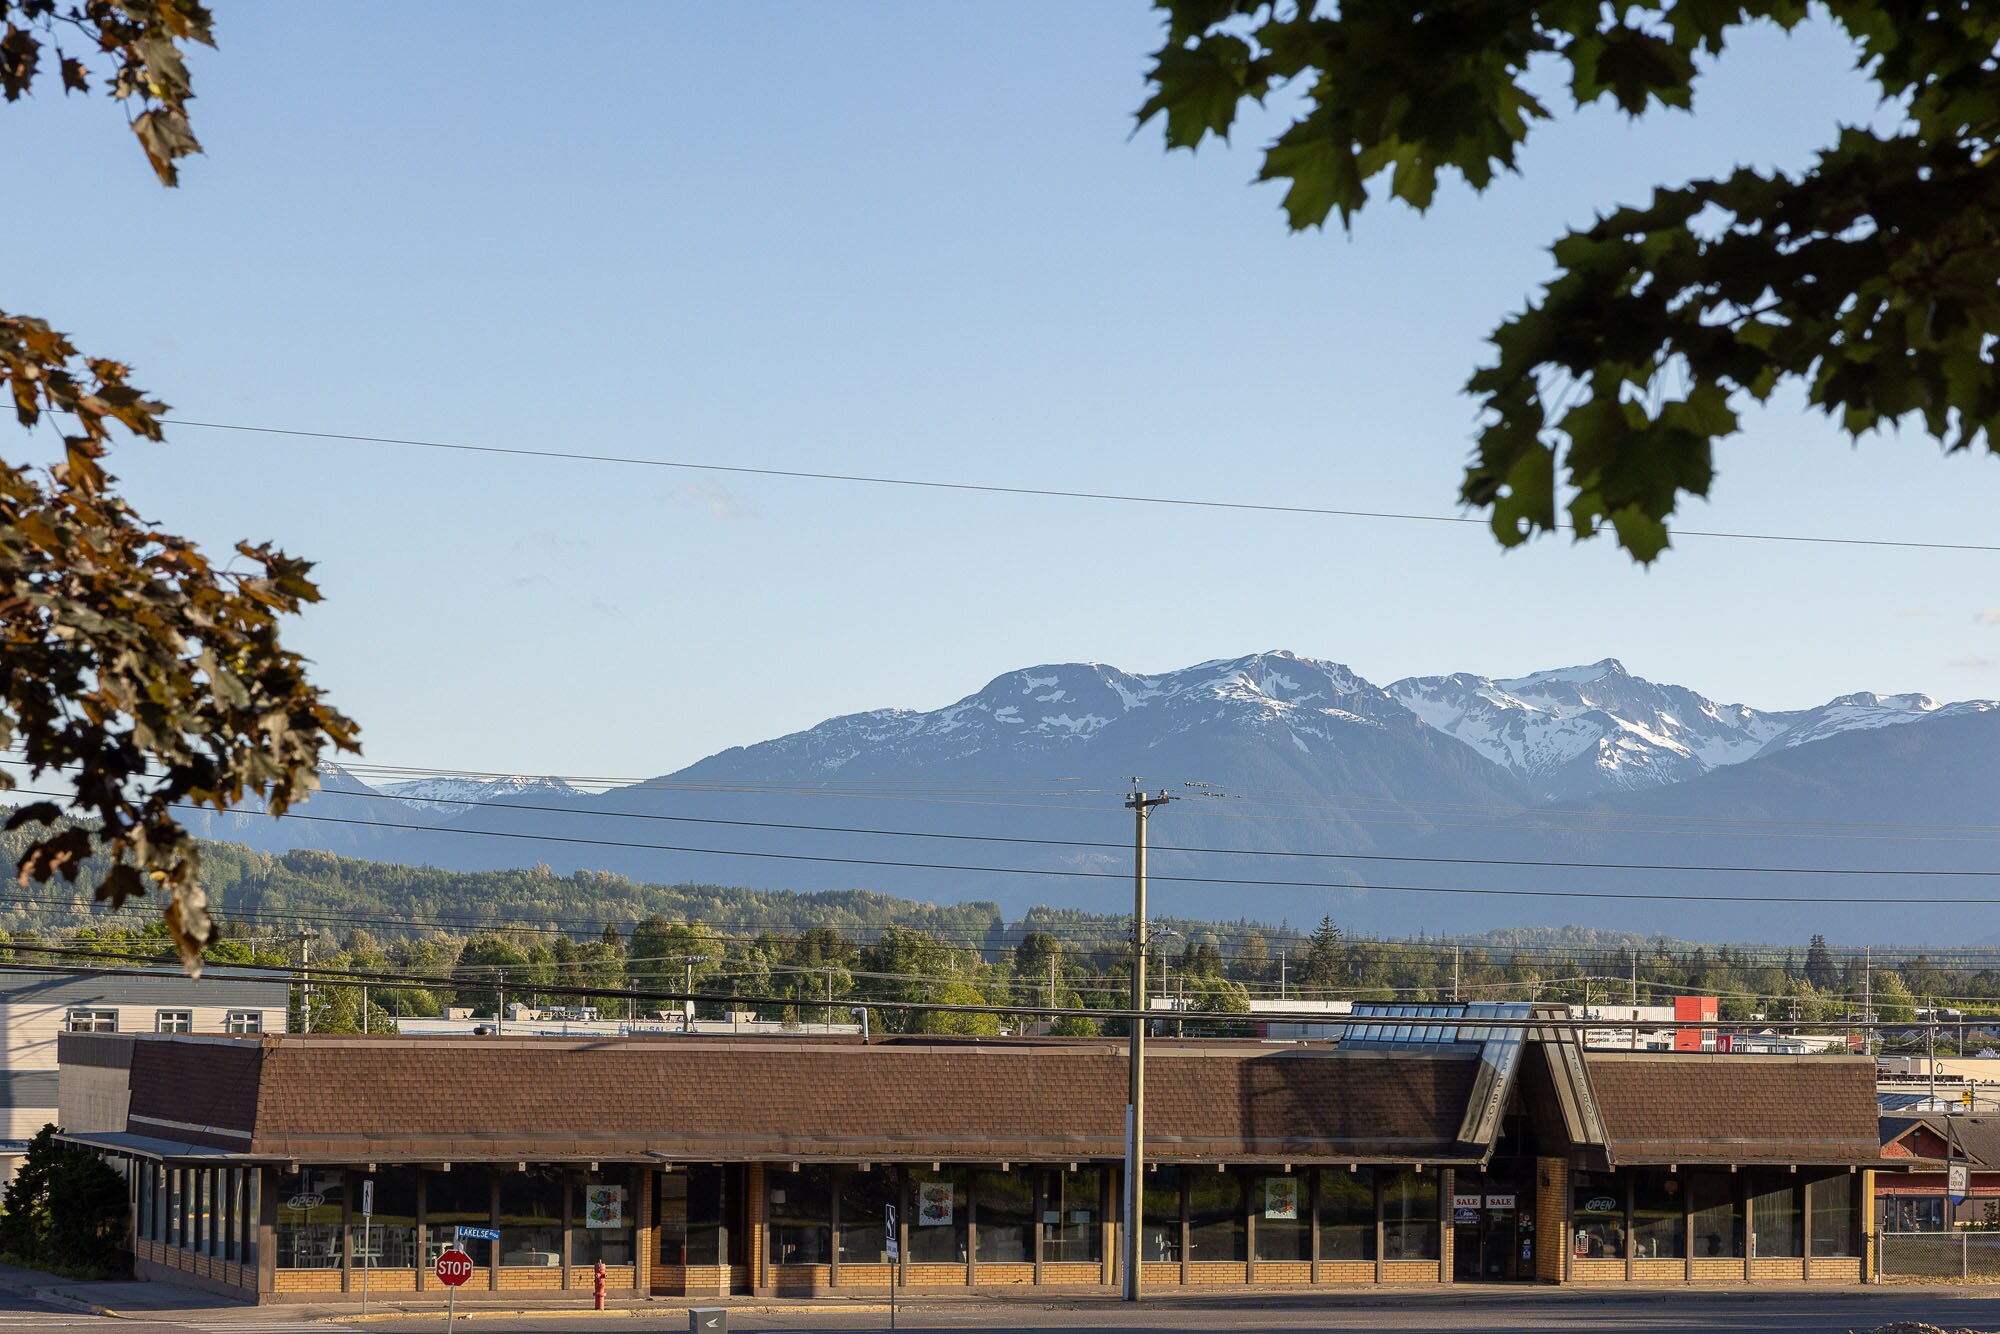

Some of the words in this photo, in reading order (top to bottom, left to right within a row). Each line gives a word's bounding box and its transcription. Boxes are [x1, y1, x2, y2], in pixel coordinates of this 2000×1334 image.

[289, 1195, 322, 1207] OPEN
[1456, 1198, 1478, 1206] SALE
[1490, 1198, 1512, 1206] SALE
[1587, 1200, 1612, 1210] OPEN
[459, 1228, 490, 1238] LAKELSE
[438, 1261, 471, 1276] STOP
